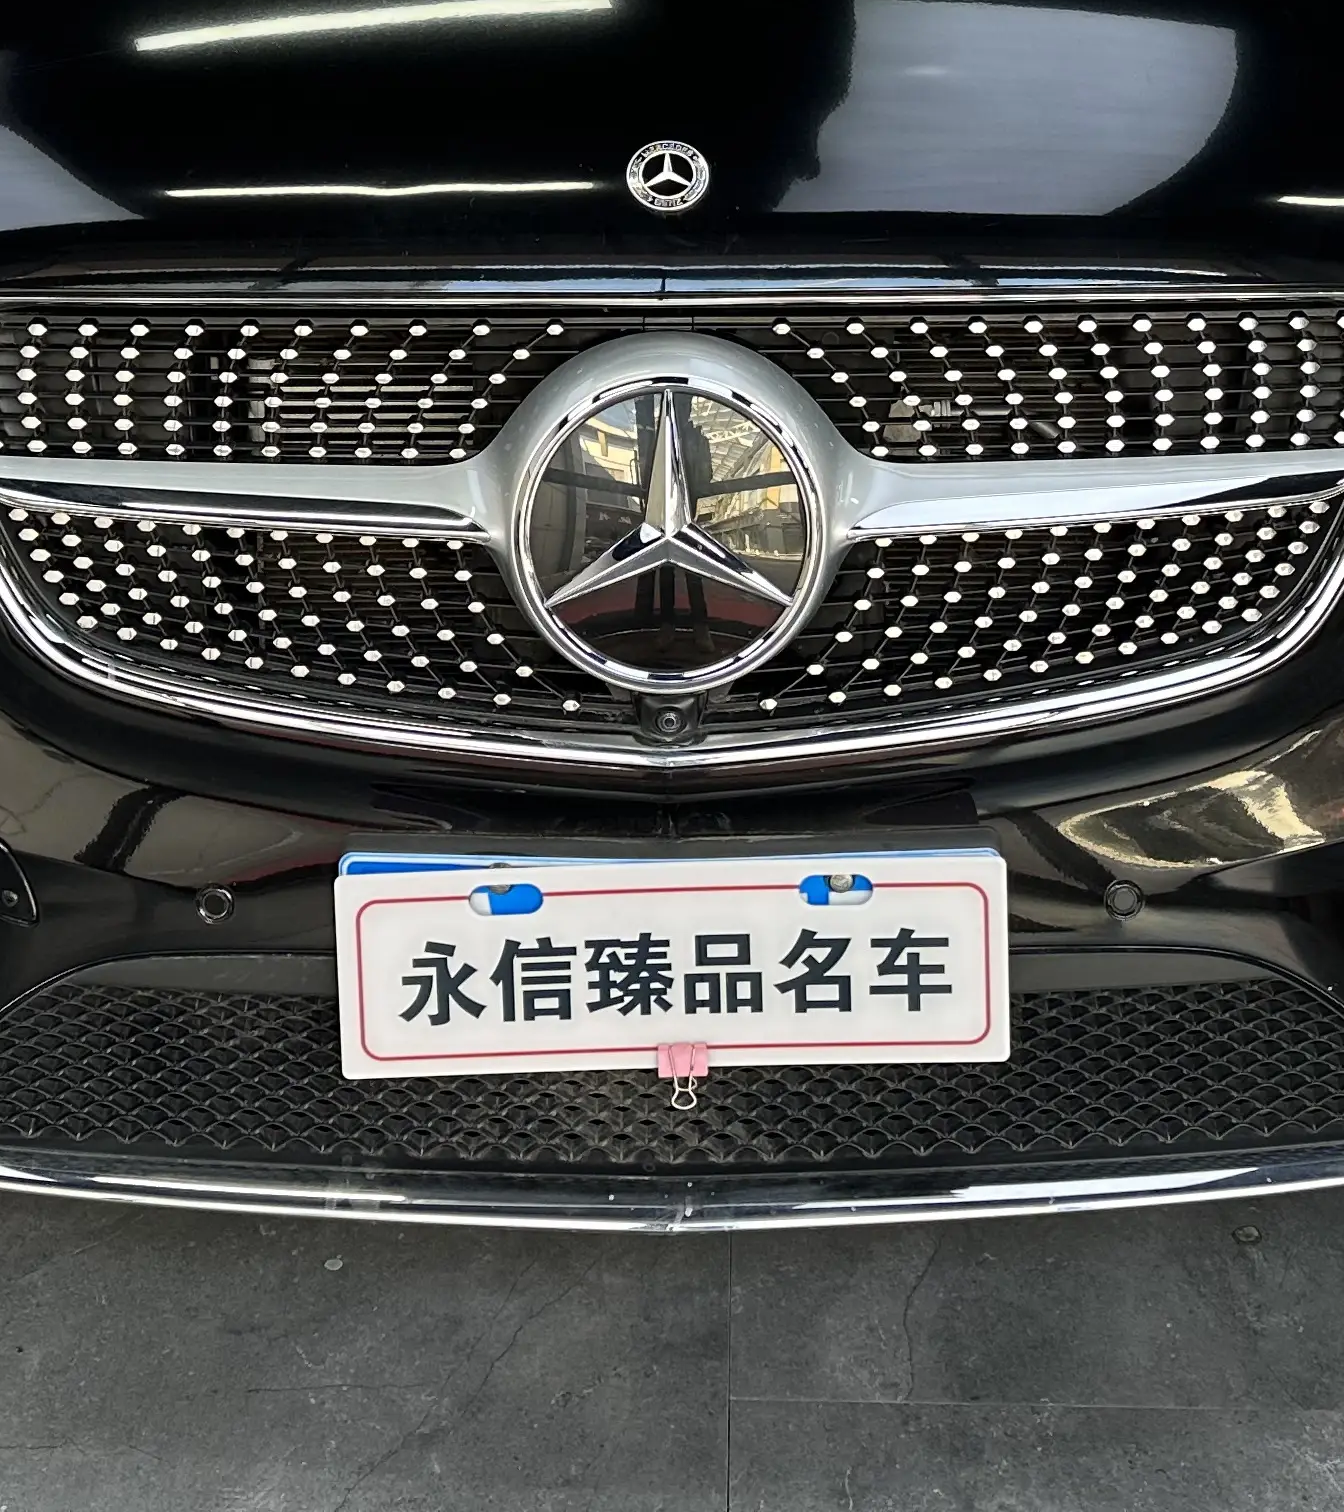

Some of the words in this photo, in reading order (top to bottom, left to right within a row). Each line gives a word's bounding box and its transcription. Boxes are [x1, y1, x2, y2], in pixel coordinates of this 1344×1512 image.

[398, 927, 955, 1028] 永信臻品名车
